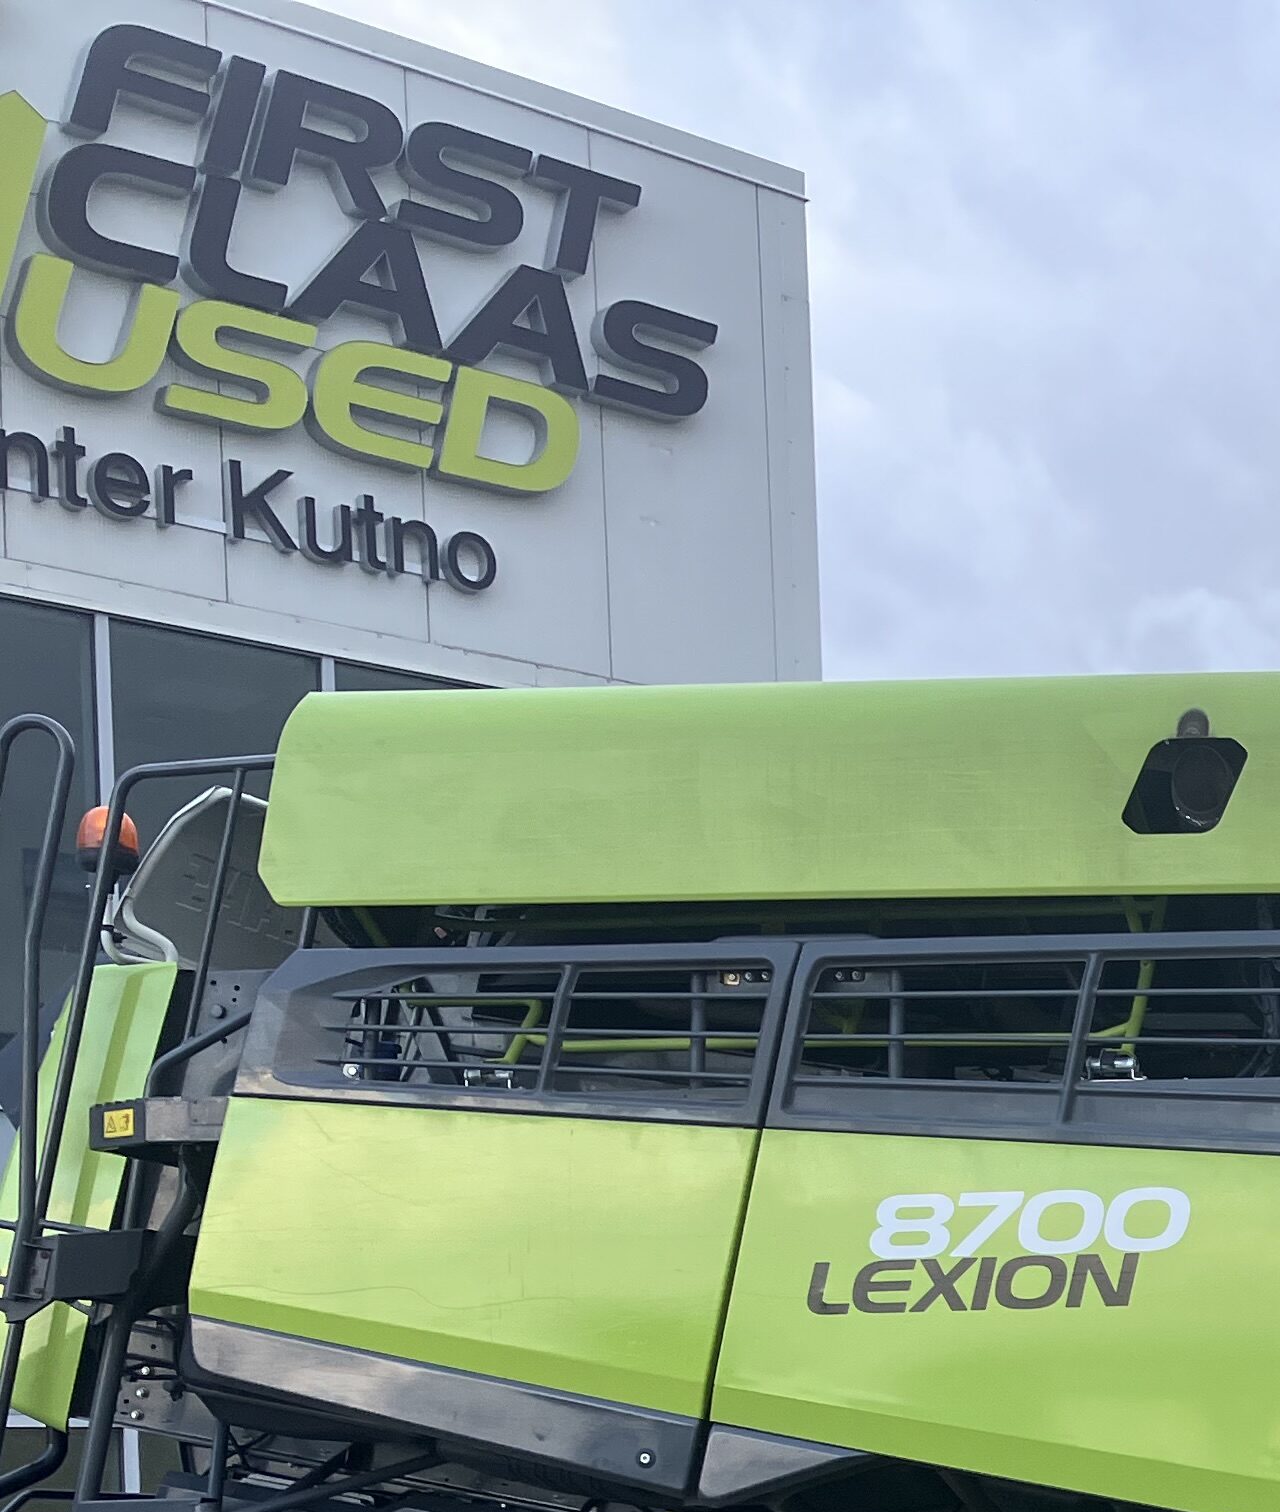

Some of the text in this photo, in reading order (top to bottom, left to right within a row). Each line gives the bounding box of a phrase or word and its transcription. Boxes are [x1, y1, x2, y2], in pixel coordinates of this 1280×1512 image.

[64, 23, 642, 280] FIRST
[8, 254, 580, 495] USED
[40, 144, 719, 420] CLAAS
[225, 459, 497, 594] Kutno
[806, 1252, 1140, 1315] LEXION
[869, 1186, 1191, 1260] 8700
